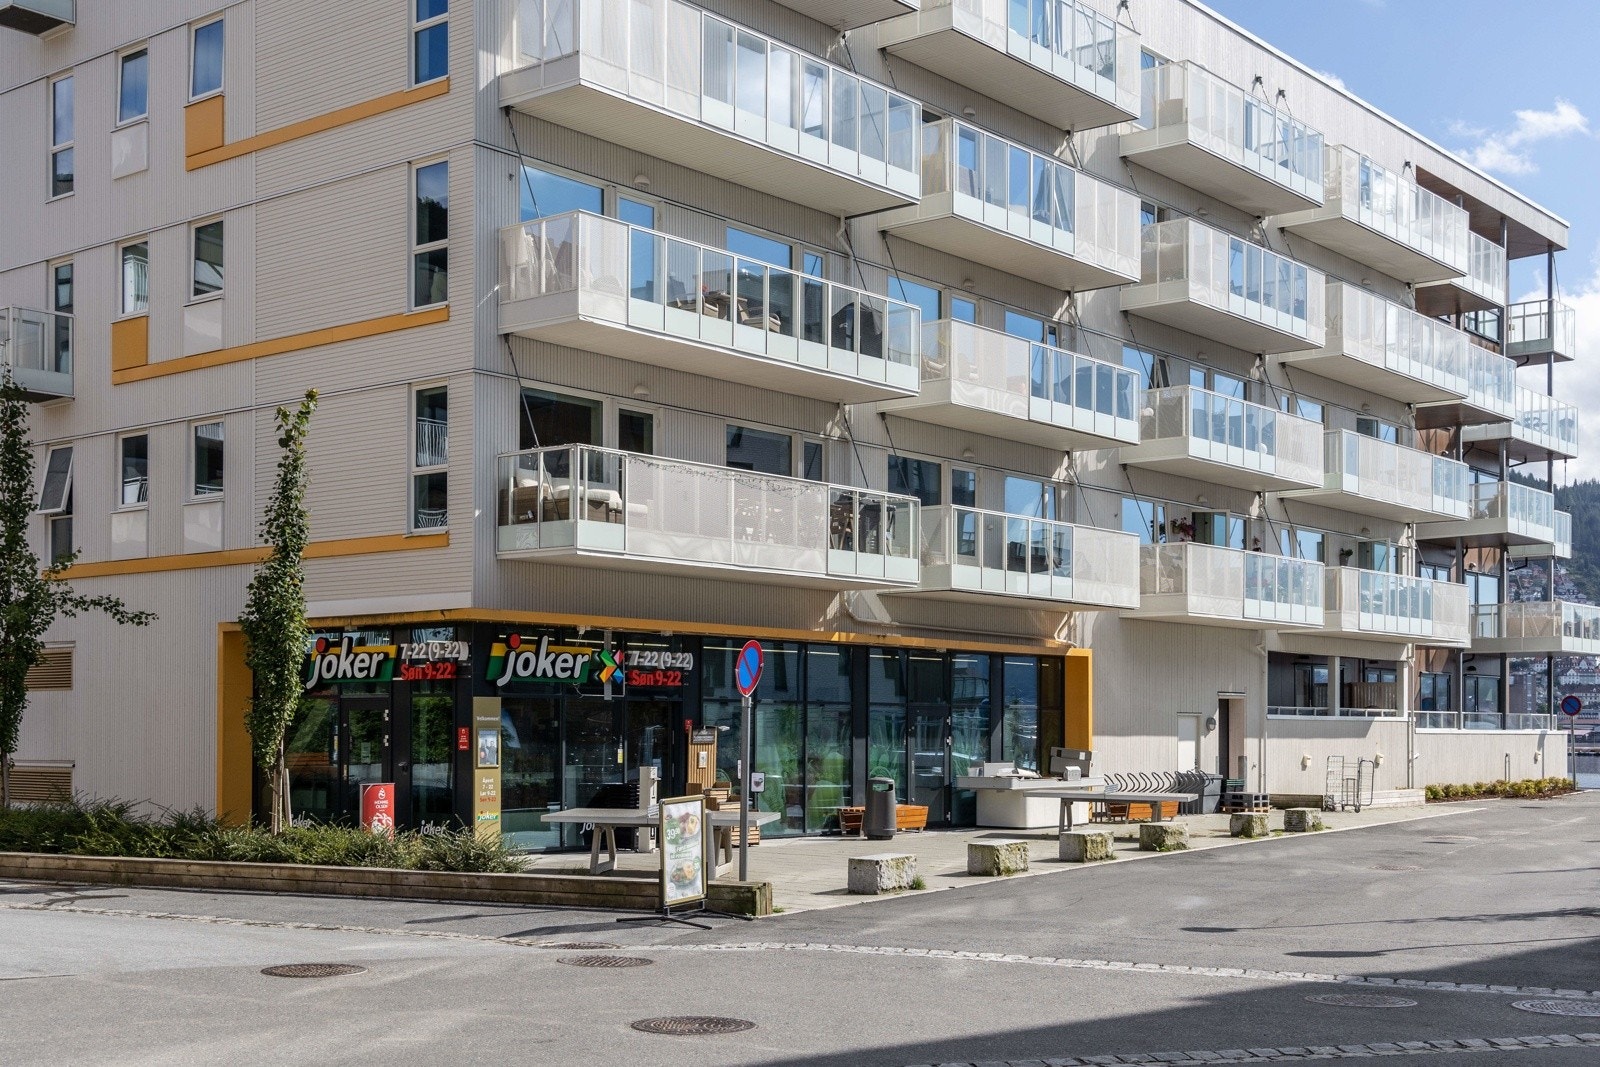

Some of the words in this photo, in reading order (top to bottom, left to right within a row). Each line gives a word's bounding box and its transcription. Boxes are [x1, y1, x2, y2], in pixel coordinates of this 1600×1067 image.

[400, 643, 427, 660] 7-22
[428, 641, 469, 661] (9-22)
[496, 633, 590, 687] joker
[629, 650, 659, 667] 7-22
[660, 651, 694, 670] (9-22)
[305, 636, 385, 689] joker
[400, 663, 423, 680] Søn
[424, 661, 454, 679] 9-22
[632, 669, 654, 686] Søn
[655, 670, 681, 686] 9-22
